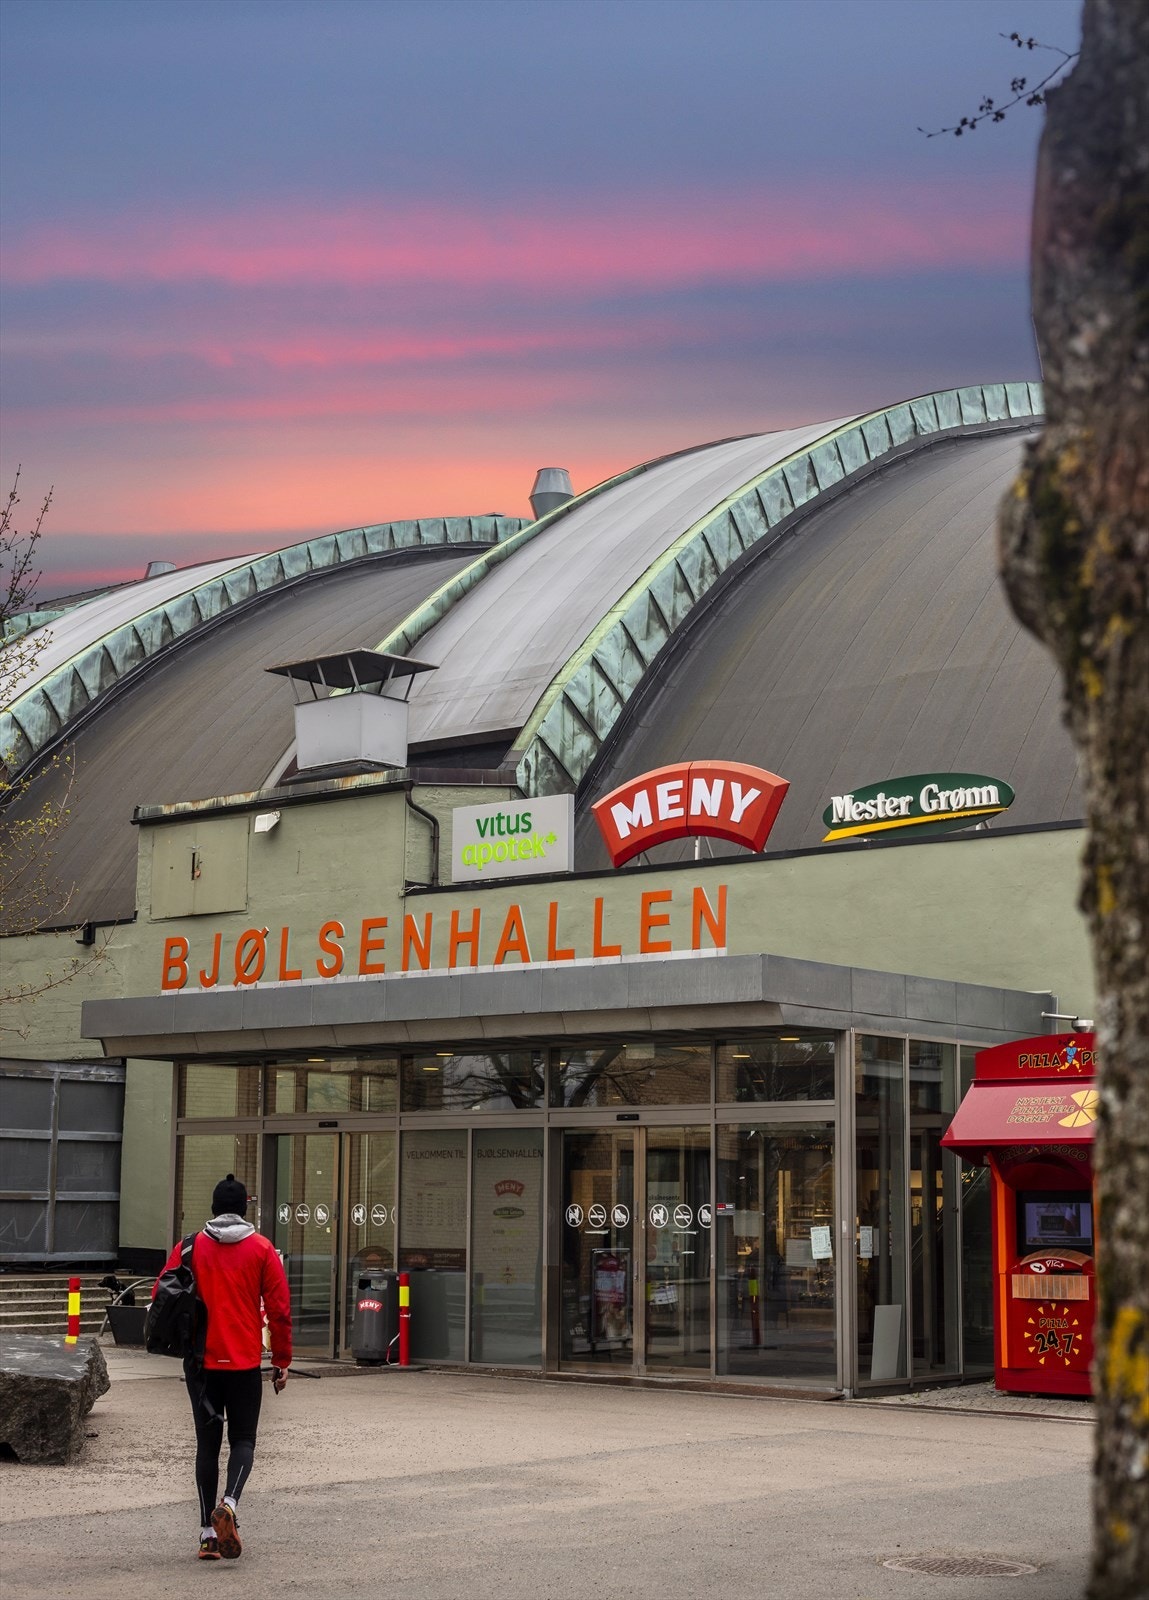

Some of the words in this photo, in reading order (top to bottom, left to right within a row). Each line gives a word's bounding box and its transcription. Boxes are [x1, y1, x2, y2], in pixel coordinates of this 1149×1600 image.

[611, 778, 762, 839] MENY
[831, 792, 914, 824] Mester
[919, 783, 1001, 813] Grønn
[476, 812, 532, 838] vitus
[161, 884, 728, 991] BJØLSENHALLEN
[1018, 1053, 1062, 1069] PIZZA
[1049, 1105, 1075, 1114] HELE
[1006, 1114, 1054, 1124] DØGNET
[406, 1150, 453, 1160] VELKOMMEN
[454, 1149, 466, 1159] TIL
[477, 1149, 544, 1159] BJØLSENHALLEN
[498, 1183, 522, 1193] MENY
[359, 1301, 379, 1309] MENY
[1039, 1318, 1069, 1329] PIZZA
